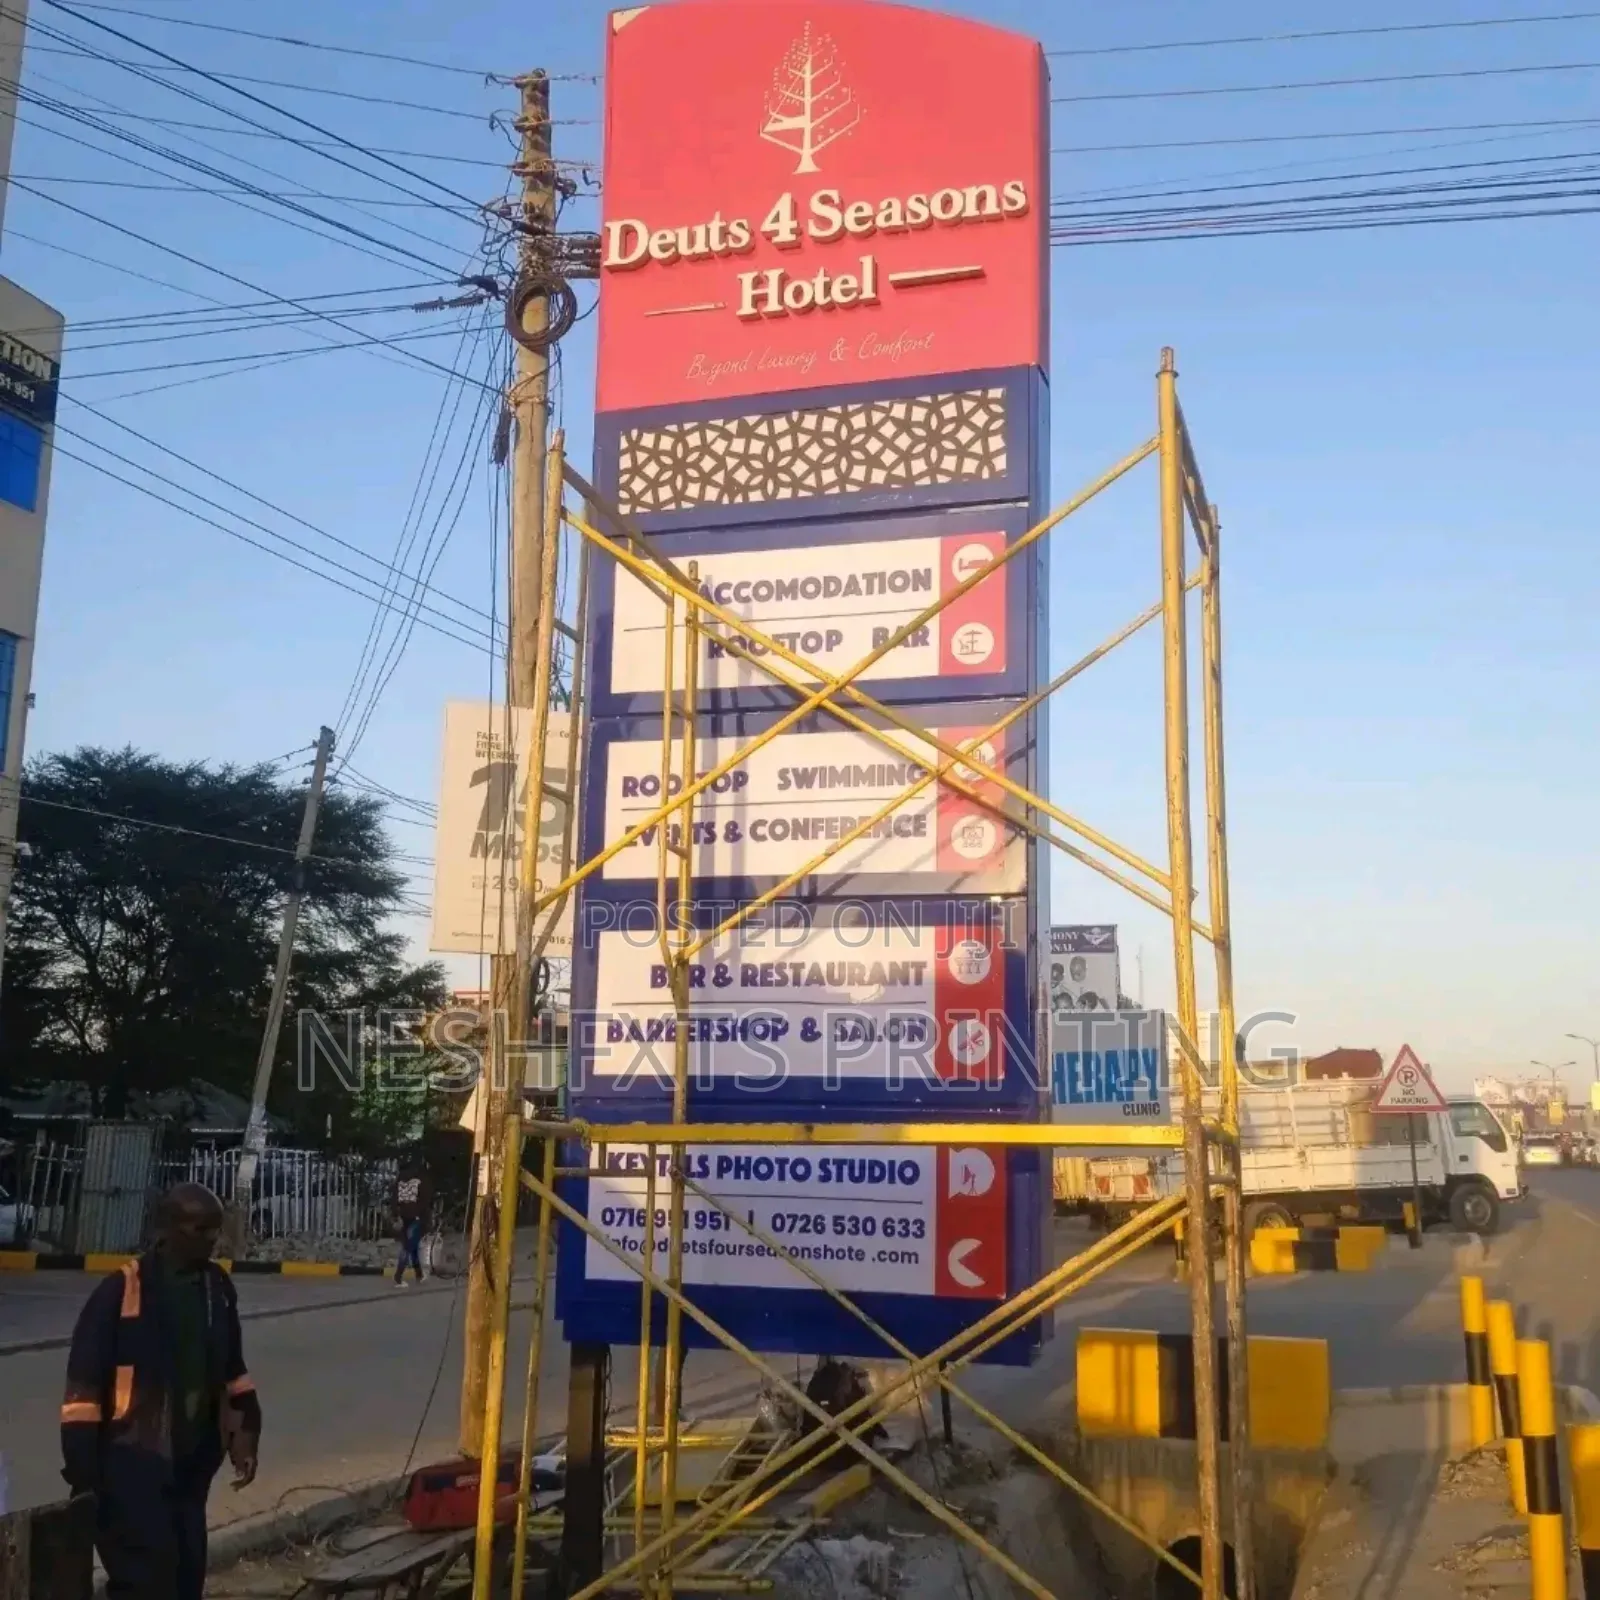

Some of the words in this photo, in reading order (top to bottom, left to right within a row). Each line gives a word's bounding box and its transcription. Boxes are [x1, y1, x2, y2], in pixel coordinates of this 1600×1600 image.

[603, 212, 752, 272] Deuts
[760, 192, 799, 243] 4
[807, 180, 1028, 239] Seasons
[736, 256, 879, 320] Hotel
[686, 353, 752, 386] Beyond
[757, 347, 817, 375] Luxury
[829, 337, 847, 363] &
[858, 330, 935, 363] Comfort
[699, 568, 932, 604] ACCOMODATION
[622, 770, 749, 797] ROOOP
[723, 820, 743, 843] &
[749, 813, 927, 842] CONFERENCE
[650, 962, 706, 989] BR
[713, 962, 733, 988] &
[741, 961, 926, 988] RESTAURANT
[606, 1016, 789, 1043] BARBERSHOP
[801, 1017, 822, 1042] &
[834, 1016, 926, 1043] SALON
[1122, 1102, 1160, 1117] CLINIC
[1390, 1097, 1428, 1105] PARKING
[607, 1152, 710, 1179] KETLS
[716, 1155, 812, 1182] PHOTO
[817, 1158, 920, 1185] STUDIO
[601, 1206, 649, 1228] 0716
[654, 1208, 690, 1230] 91
[694, 1209, 731, 1231] 951
[771, 1212, 826, 1236] 0726
[832, 1214, 877, 1237] 530
[882, 1216, 926, 1240] 633
[605, 1234, 866, 1263] fo@detsfourseaonshote
